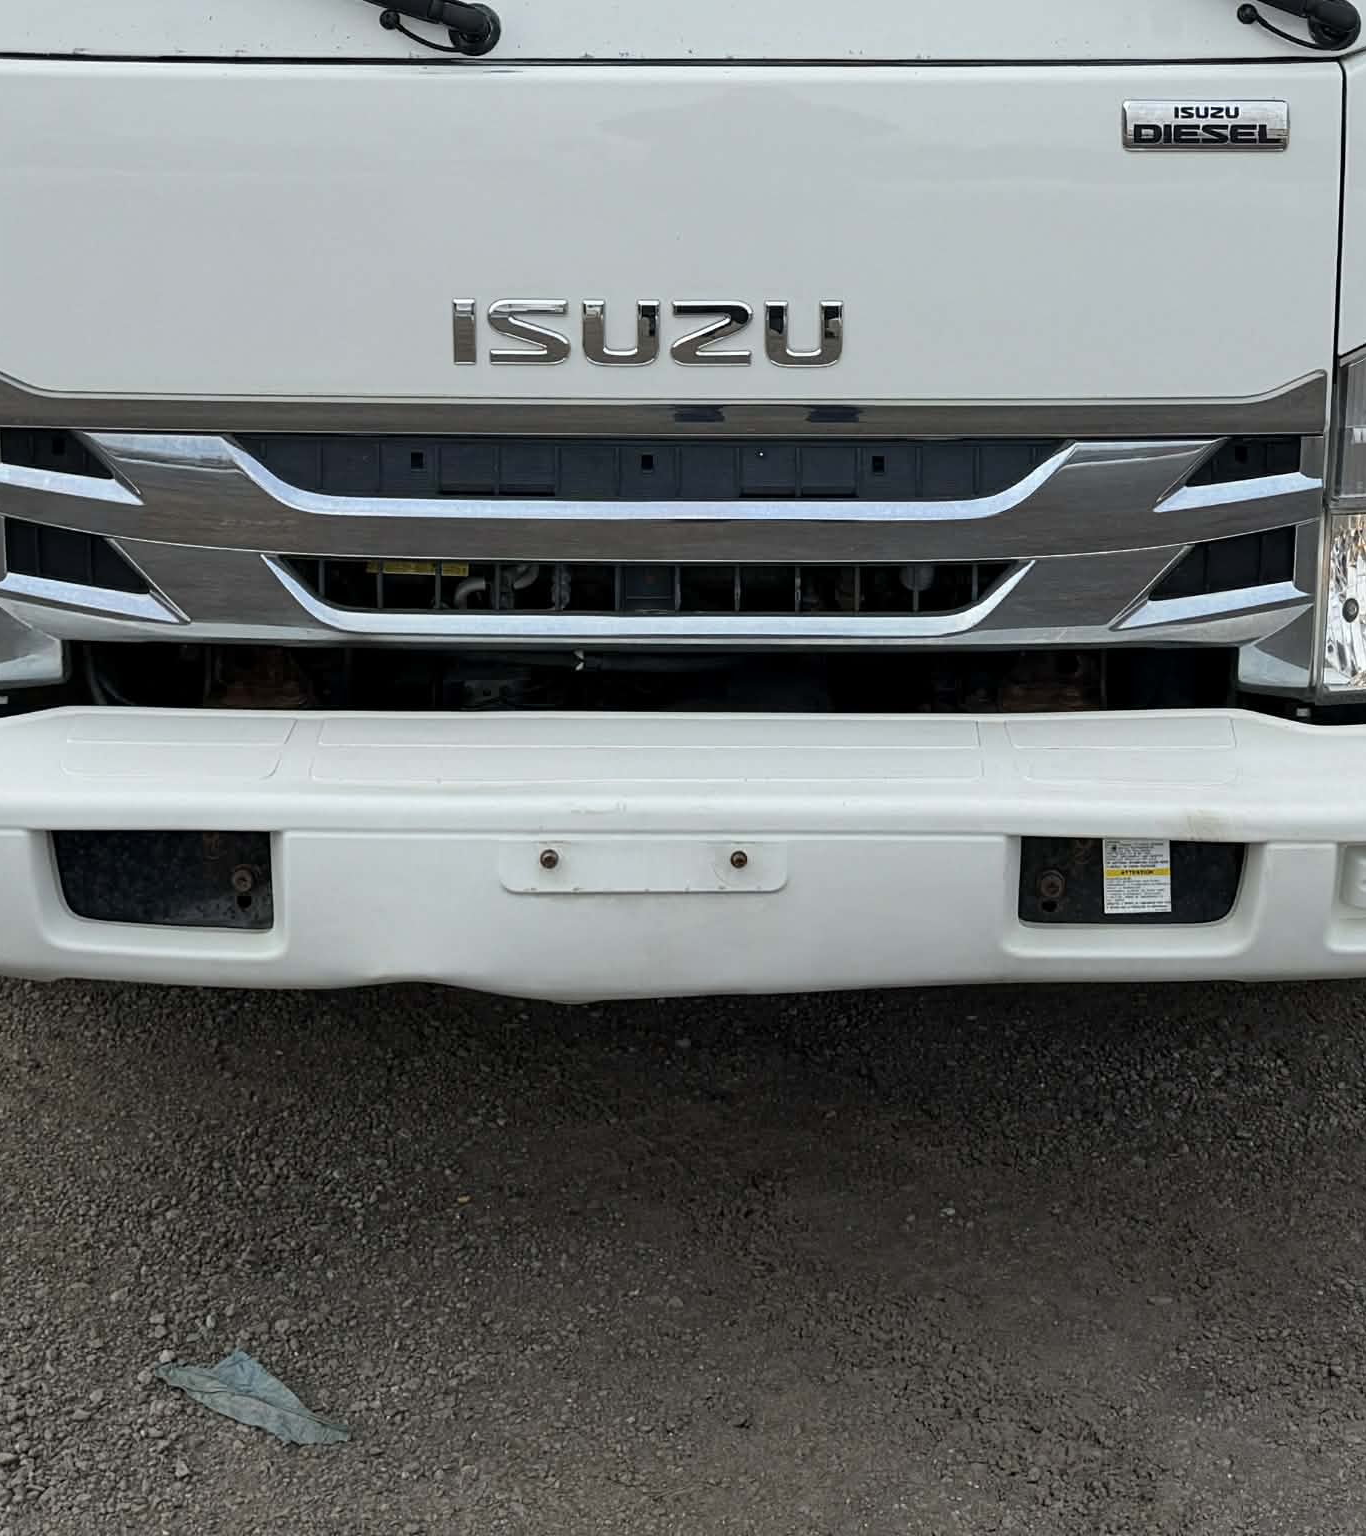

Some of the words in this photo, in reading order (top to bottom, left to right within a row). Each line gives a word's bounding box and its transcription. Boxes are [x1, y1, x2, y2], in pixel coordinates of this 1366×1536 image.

[1174, 106, 1239, 119] ISUZU
[1134, 124, 1286, 144] DIESEL
[452, 298, 845, 368] ISUZU
